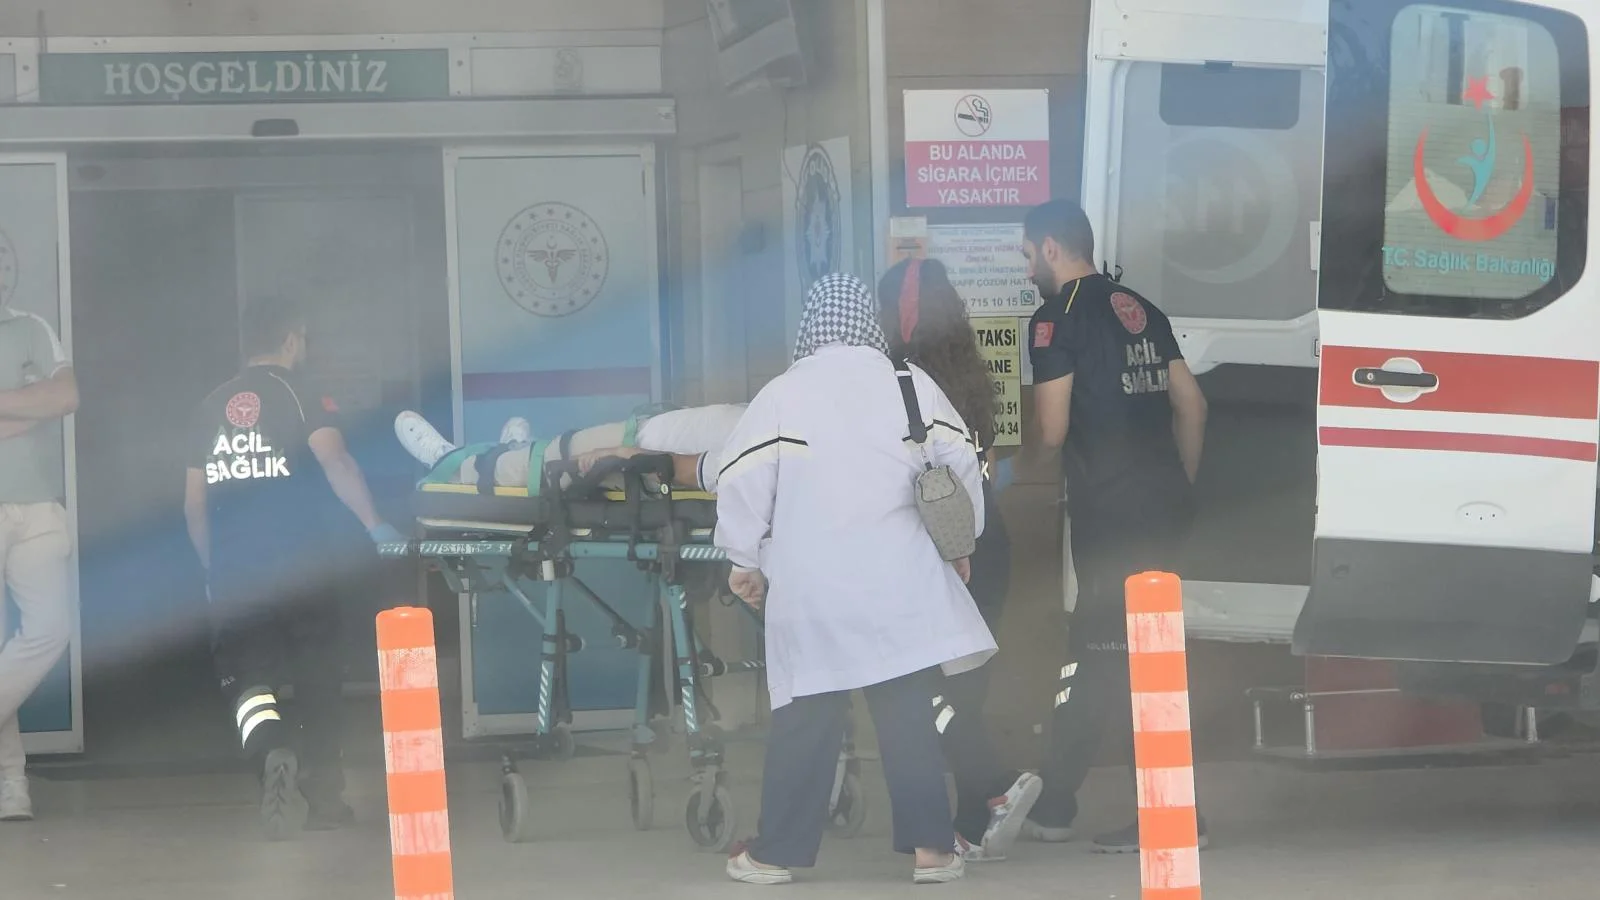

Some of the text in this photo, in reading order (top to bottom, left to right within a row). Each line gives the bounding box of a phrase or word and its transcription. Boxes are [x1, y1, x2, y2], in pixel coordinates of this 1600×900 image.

[103, 53, 388, 101] HOŞGELDİNİZ
[930, 144, 1026, 161] BU ALANDA
[918, 163, 1038, 185] SİGARA İÇMEK
[938, 188, 1020, 204] YASAKTIR
[1382, 246, 1555, 282] T.C. Sağlık Bakanlığı
[971, 298, 989, 307] 715
[993, 297, 1003, 306] 10
[1007, 297, 1018, 306] 15
[1126, 337, 1162, 366] ACİL
[987, 360, 1012, 374] ANE
[1007, 402, 1017, 415] 51
[1008, 422, 1019, 435] 34
[213, 431, 272, 455] ACİL
[206, 455, 290, 484] SAĞLIK
